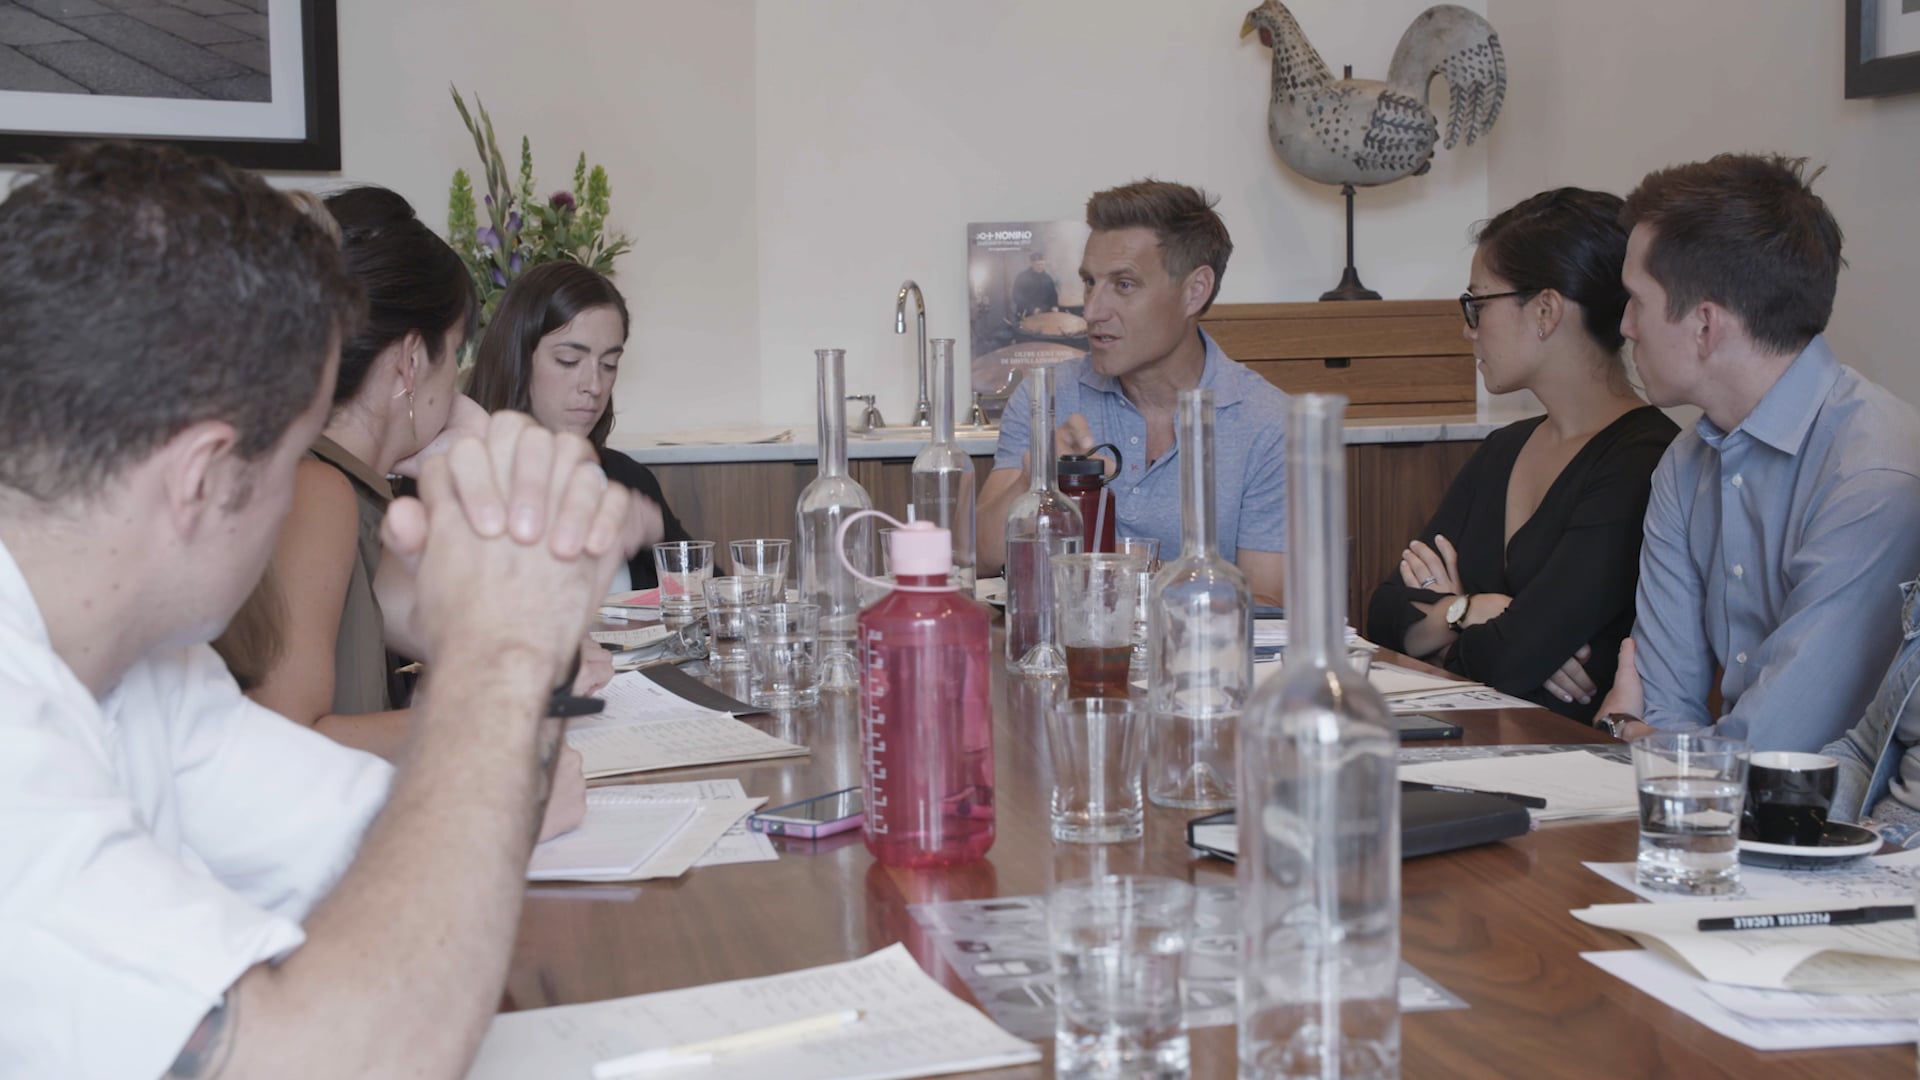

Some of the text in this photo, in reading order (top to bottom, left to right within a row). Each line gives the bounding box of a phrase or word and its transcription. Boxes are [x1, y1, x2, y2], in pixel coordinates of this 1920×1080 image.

[995, 231, 1032, 240] NONINO
[1733, 912, 1831, 929] PIZZERIA LOCALE
